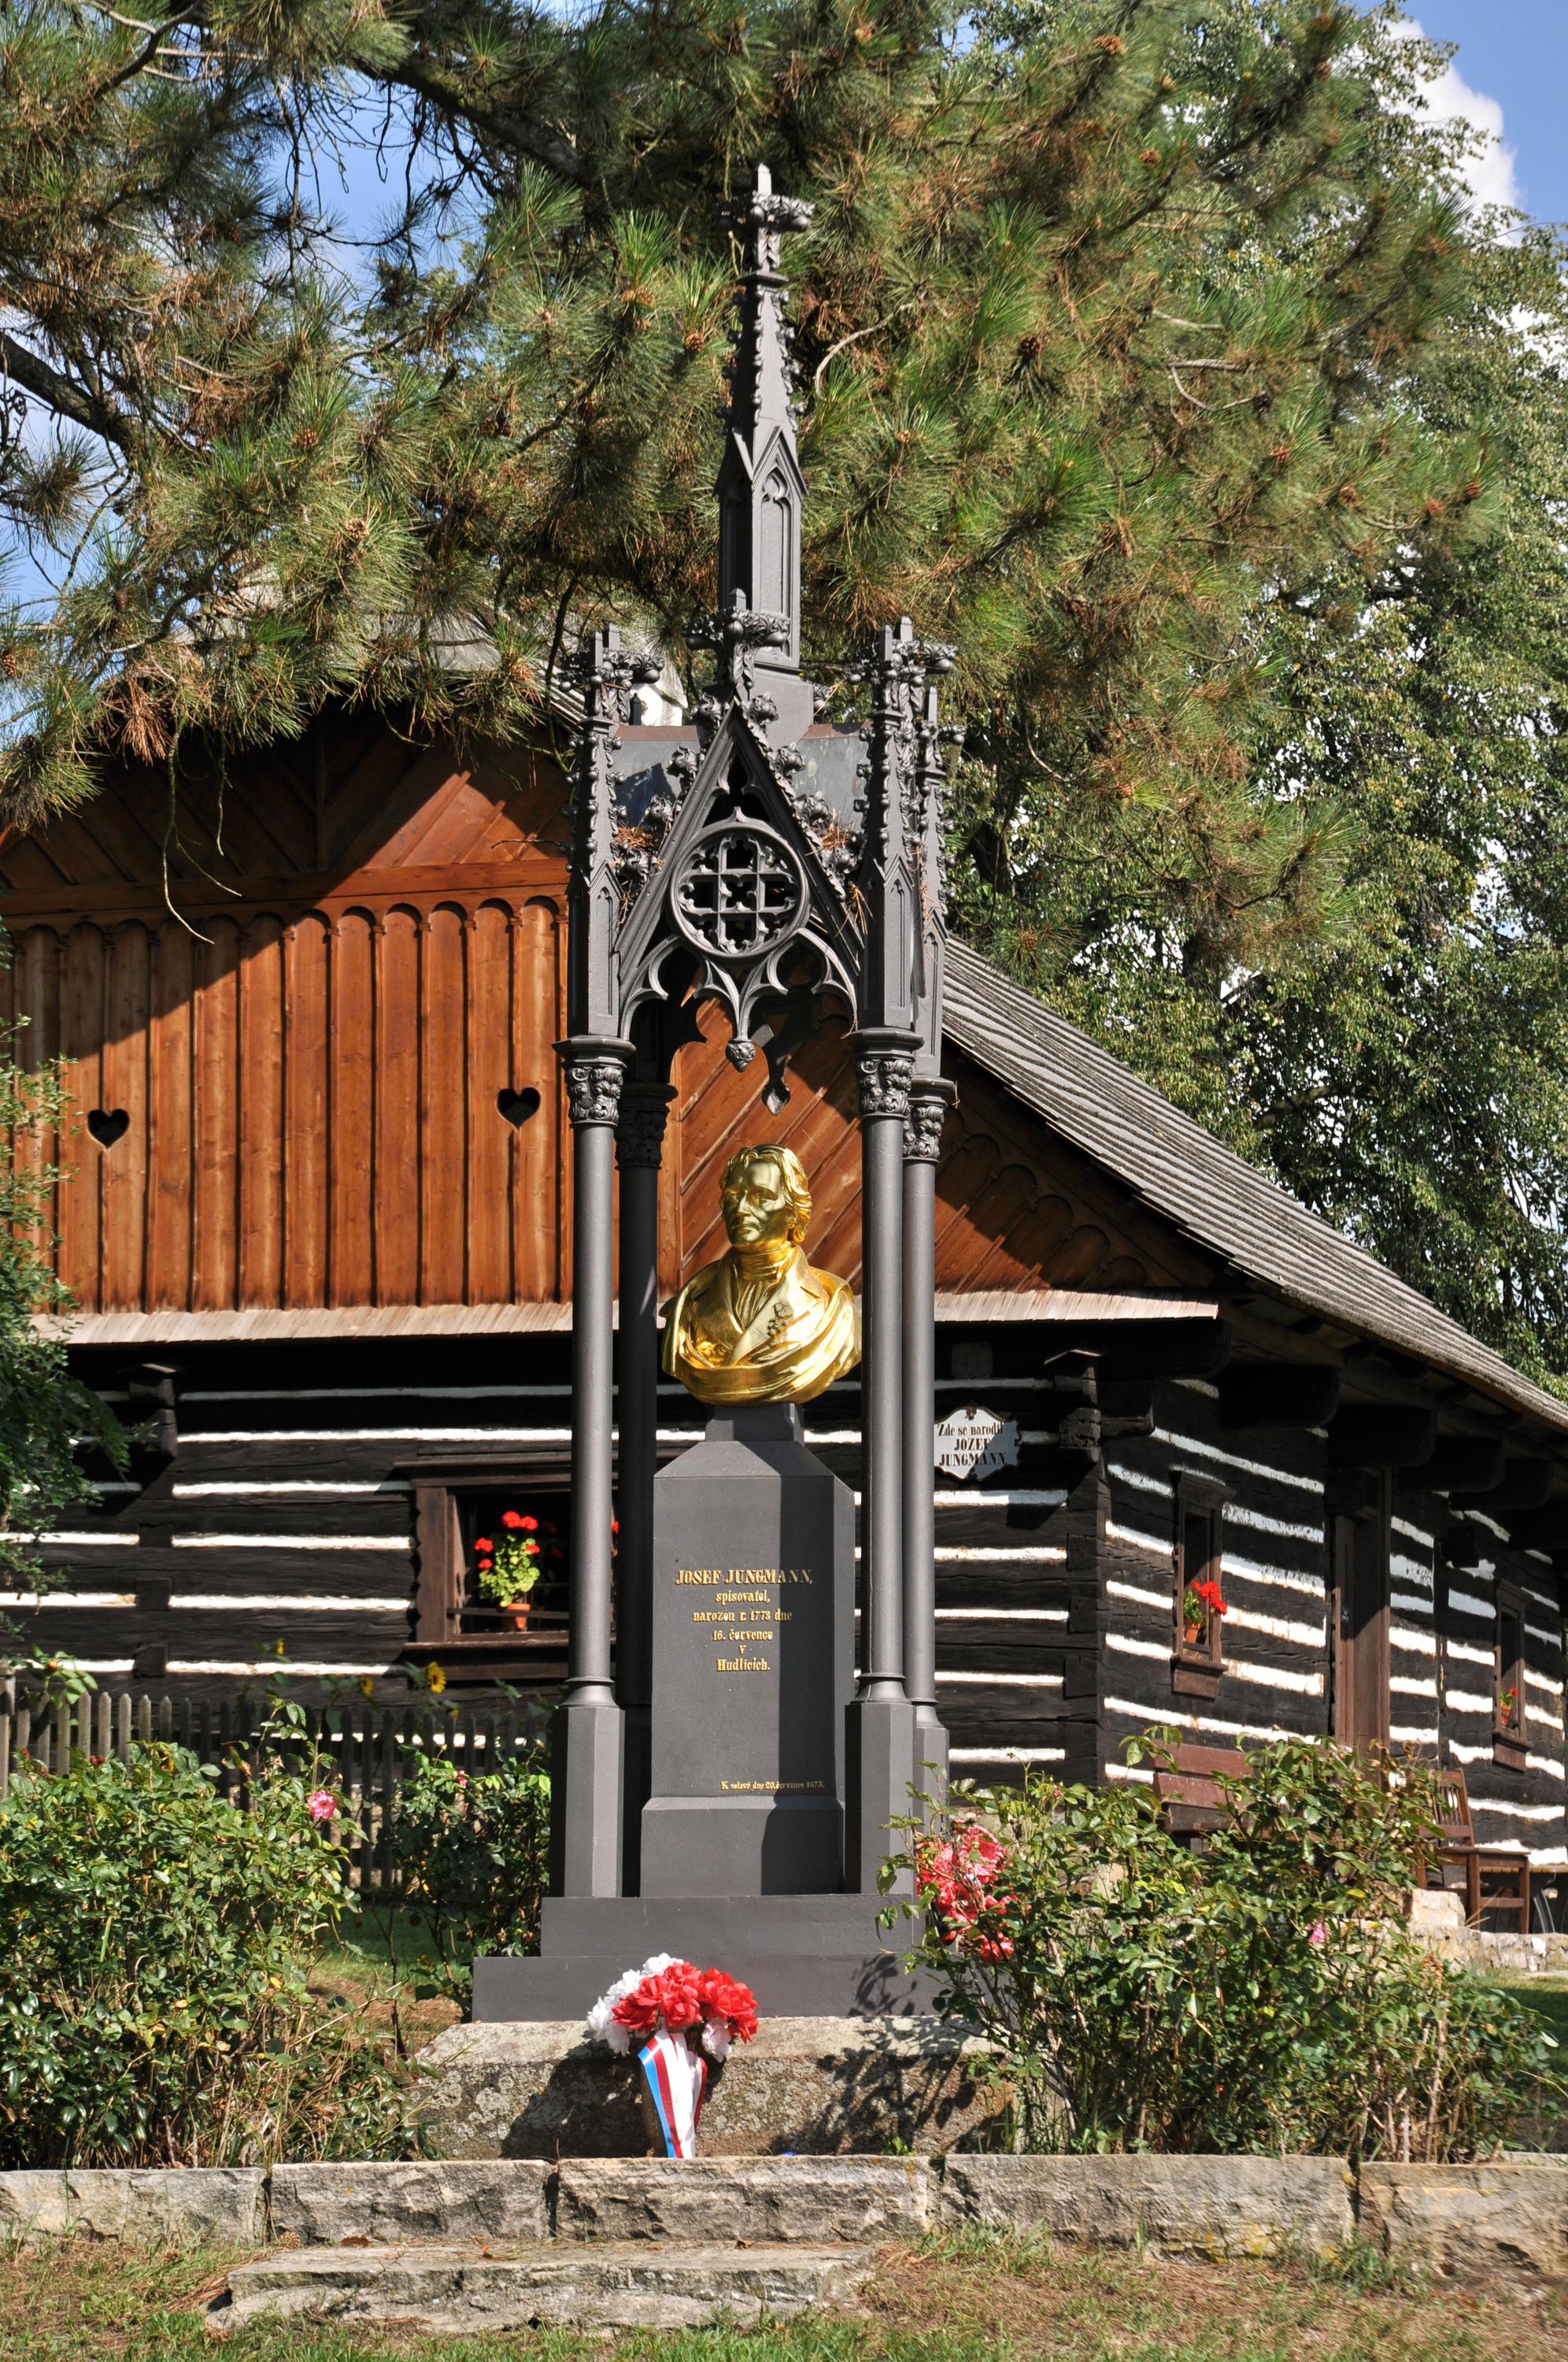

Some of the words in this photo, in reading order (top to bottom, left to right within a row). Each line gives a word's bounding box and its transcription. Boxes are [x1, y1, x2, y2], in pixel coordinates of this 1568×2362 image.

[938, 1423, 956, 1436] Zde
[958, 1427, 967, 1436] se
[971, 1422, 1004, 1435] narodil
[954, 1438, 990, 1450] JOZEF
[675, 1569, 721, 1585] JOSEF
[724, 1569, 813, 1585] JUNGMANN,
[716, 1590, 771, 1605] spisovatel,
[693, 1610, 735, 1622] narozen
[739, 1611, 747, 1622] r.
[749, 1610, 771, 1621] 1778
[774, 1608, 793, 1622] dne
[712, 1630, 726, 1641] 16.
[729, 1628, 773, 1641] července
[716, 1657, 771, 1672] Hudlicích.
[721, 1781, 729, 1790] K
